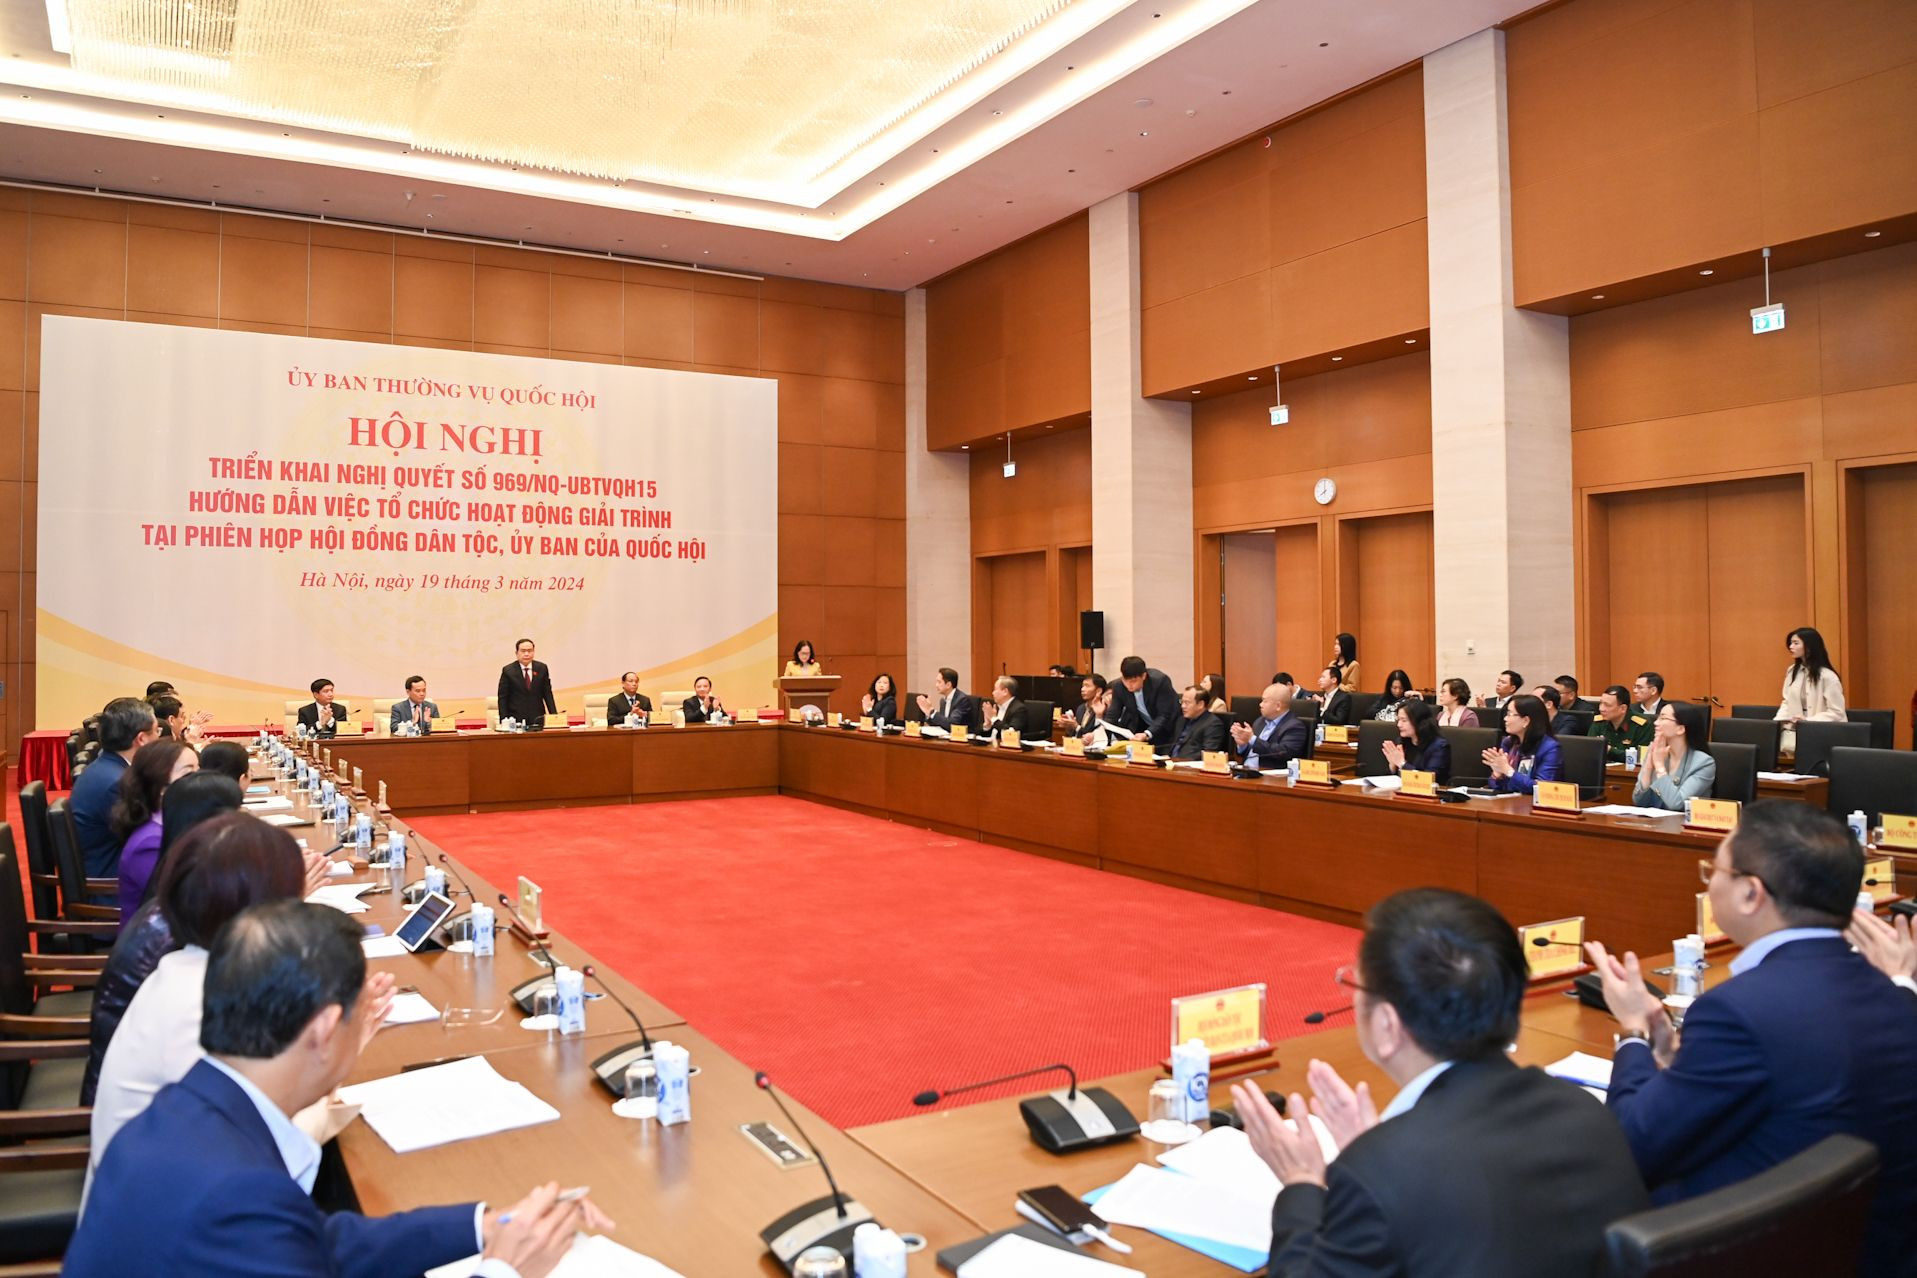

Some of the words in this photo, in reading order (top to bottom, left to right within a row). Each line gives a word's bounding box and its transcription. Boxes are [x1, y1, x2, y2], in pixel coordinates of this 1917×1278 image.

[288, 366, 317, 387] ỦY
[324, 373, 367, 391] BAN
[373, 376, 461, 399] THƯỜNG
[468, 385, 495, 404] VỤ
[500, 384, 556, 406] QUỐC
[562, 390, 597, 412] HỘI
[348, 411, 428, 457] HỘI
[439, 422, 544, 465] NGHỊ
[209, 451, 272, 480] TRIỂN
[280, 461, 330, 483] KHAI
[337, 464, 386, 490] NGHỊ
[394, 462, 455, 489] QUYẾT
[461, 464, 486, 490] SỐ
[493, 472, 657, 499] 969/NQ-UBTVQH15
[189, 488, 265, 514] HƯỚNG
[273, 487, 317, 516] DẪN
[324, 493, 370, 521] VIỆC
[377, 491, 402, 519] TỔ
[408, 497, 460, 521] CHỨC
[467, 502, 516, 526] HOẠT
[522, 501, 573, 528] ĐỘNG
[579, 502, 614, 527] GIẢI
[621, 506, 672, 529] TRÌNH
[142, 524, 177, 550] TẠI
[185, 522, 251, 548] PHIÊN
[260, 528, 303, 553] HỌP
[310, 525, 345, 554] HỘI
[352, 523, 408, 552] ĐỒNG
[415, 529, 456, 553] DÂN
[462, 530, 504, 557] TỘC,
[510, 529, 534, 555] ỦY
[540, 537, 578, 556] BAN
[584, 532, 620, 558] CỦA
[626, 533, 672, 560] QUỐC
[678, 538, 706, 563] HỘI
[300, 572, 326, 588] Hà
[332, 572, 368, 591] Nội,
[375, 576, 414, 592] ngày
[420, 574, 439, 589] 19
[444, 575, 490, 593] tháng
[495, 575, 504, 590] 3
[509, 577, 543, 591] năm
[548, 576, 585, 591] 2024
